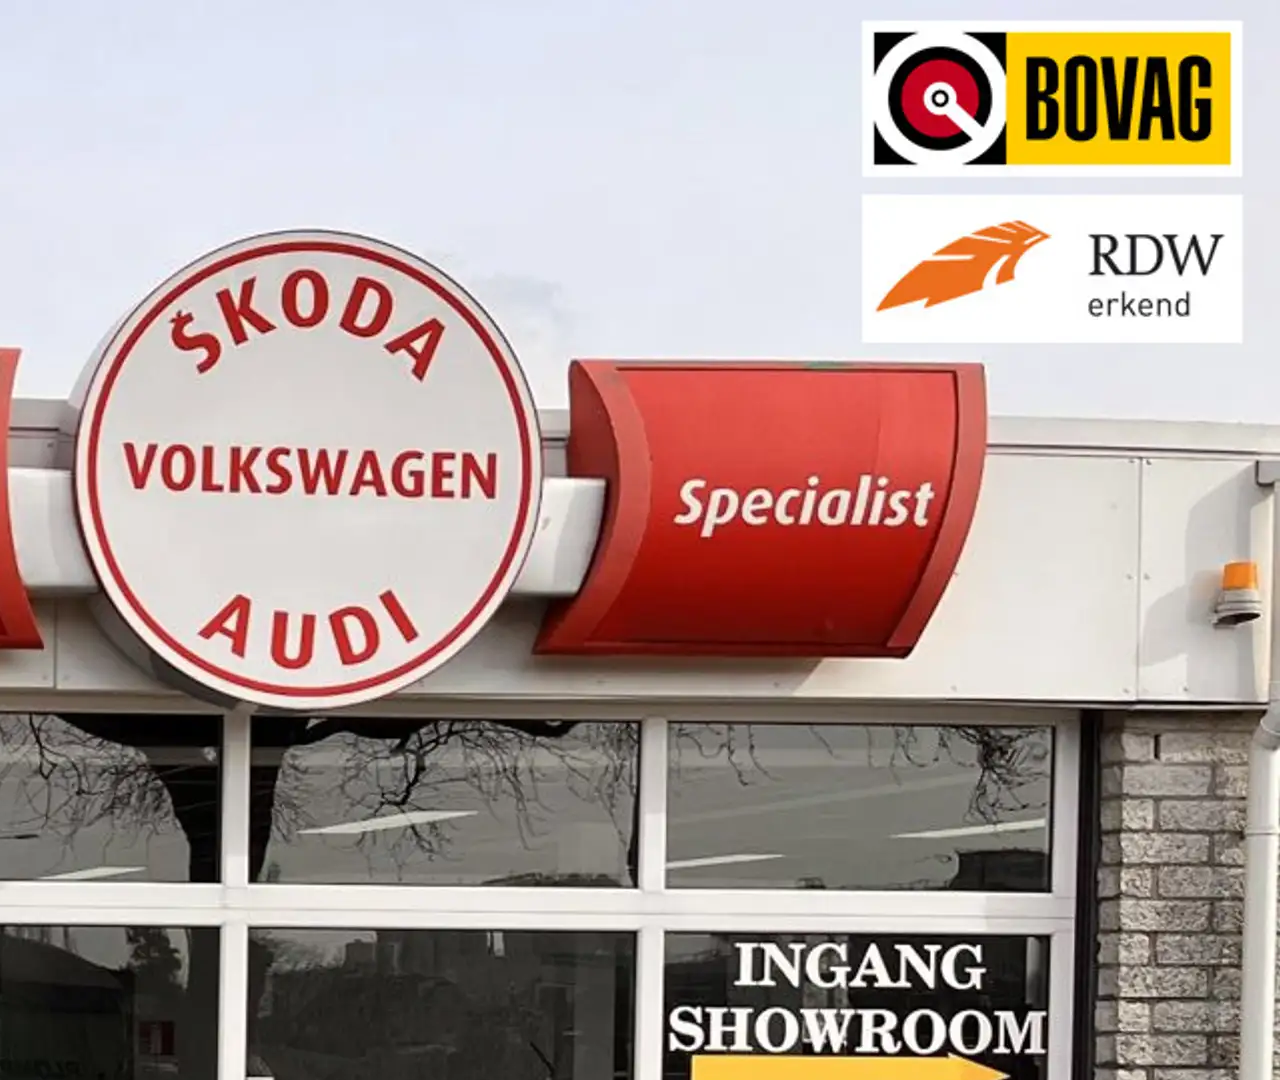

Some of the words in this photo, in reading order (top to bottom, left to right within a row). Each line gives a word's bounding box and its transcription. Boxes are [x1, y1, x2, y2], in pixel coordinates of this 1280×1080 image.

[169, 268, 446, 381] ŠKODA
[123, 442, 497, 499] VOLKSWAGEN
[674, 475, 935, 538] Specialist
[198, 589, 419, 669] AUDI
[734, 942, 986, 990] INGANG
[668, 1006, 1048, 1055] SHOWROOM
